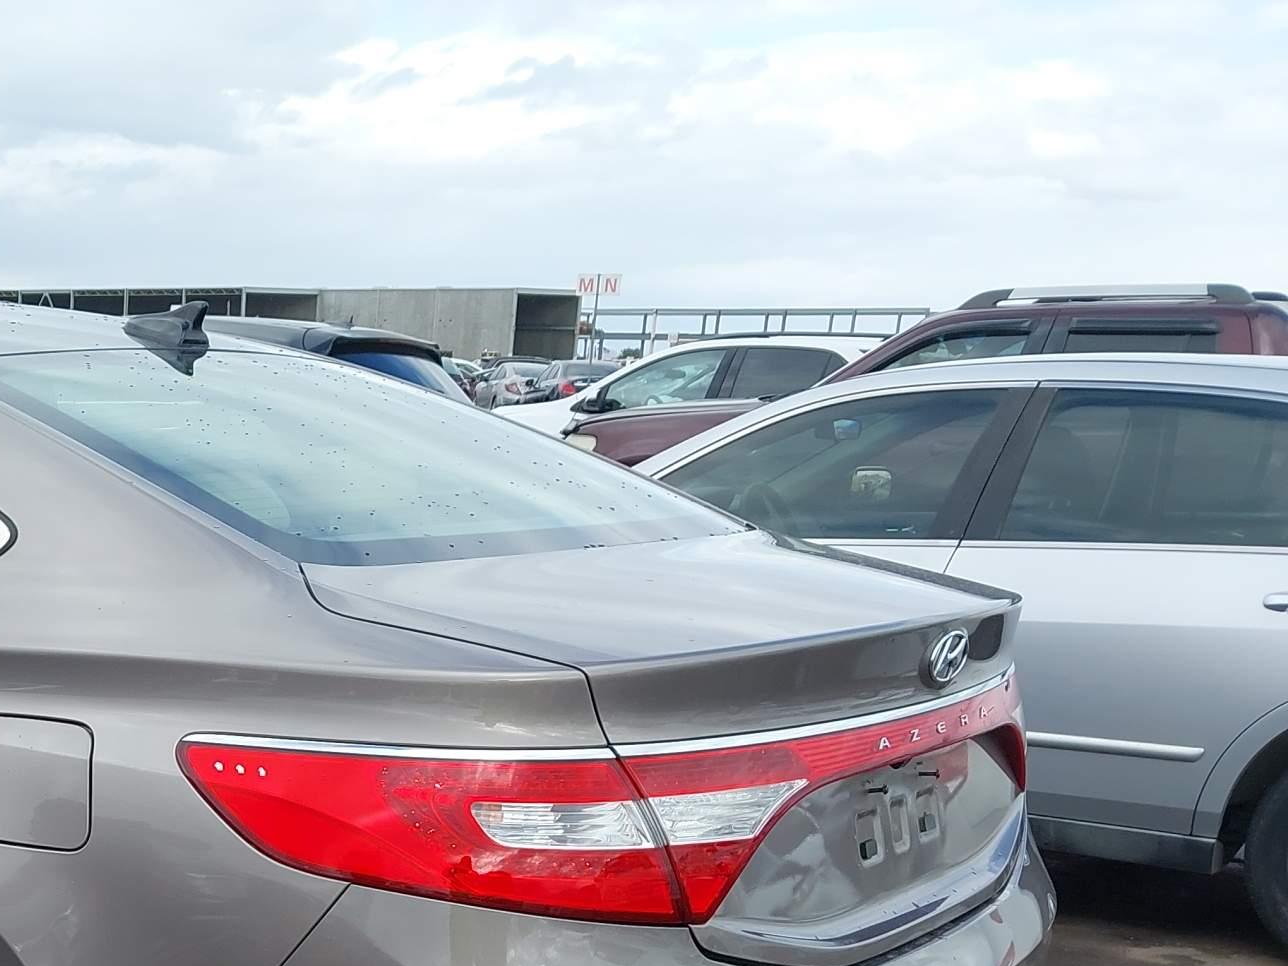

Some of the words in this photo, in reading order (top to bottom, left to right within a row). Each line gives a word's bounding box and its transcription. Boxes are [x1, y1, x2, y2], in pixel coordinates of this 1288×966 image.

[578, 277, 594, 293] M
[604, 277, 618, 293] N
[878, 705, 993, 751] AZERA
